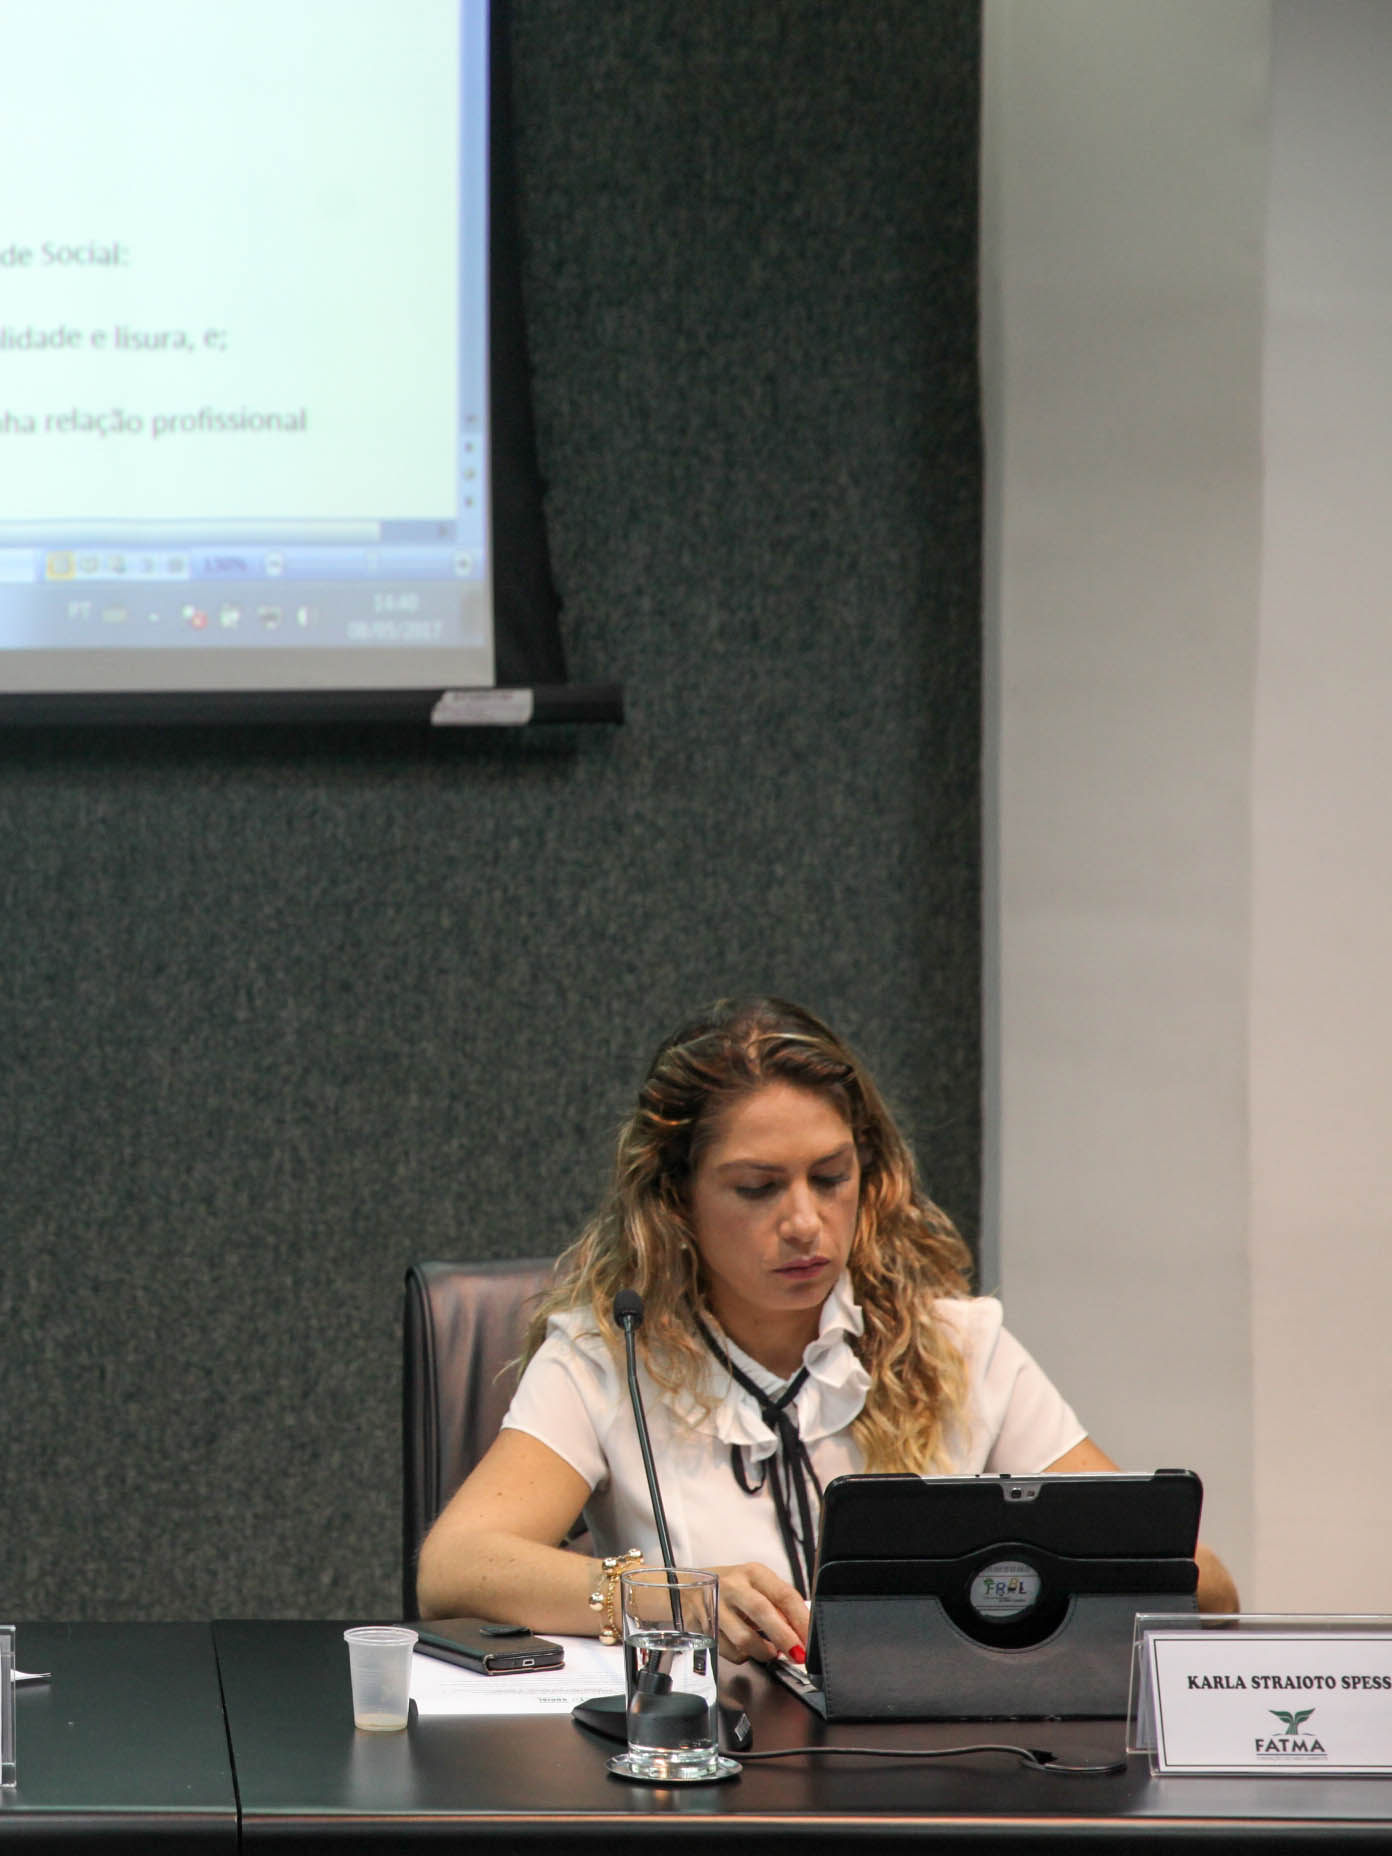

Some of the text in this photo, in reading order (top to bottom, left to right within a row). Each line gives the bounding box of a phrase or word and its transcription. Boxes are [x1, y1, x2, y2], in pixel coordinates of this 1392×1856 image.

[40, 241, 130, 268] Social:
[89, 329, 108, 350] e
[113, 325, 196, 354] lisura,
[202, 327, 228, 352] e;
[44, 407, 145, 439] relação
[151, 405, 308, 441] profissional
[1187, 1675, 1246, 1689] KARLA
[1251, 1675, 1337, 1690] STRAIOTO
[1255, 1739, 1326, 1753] FATMA
